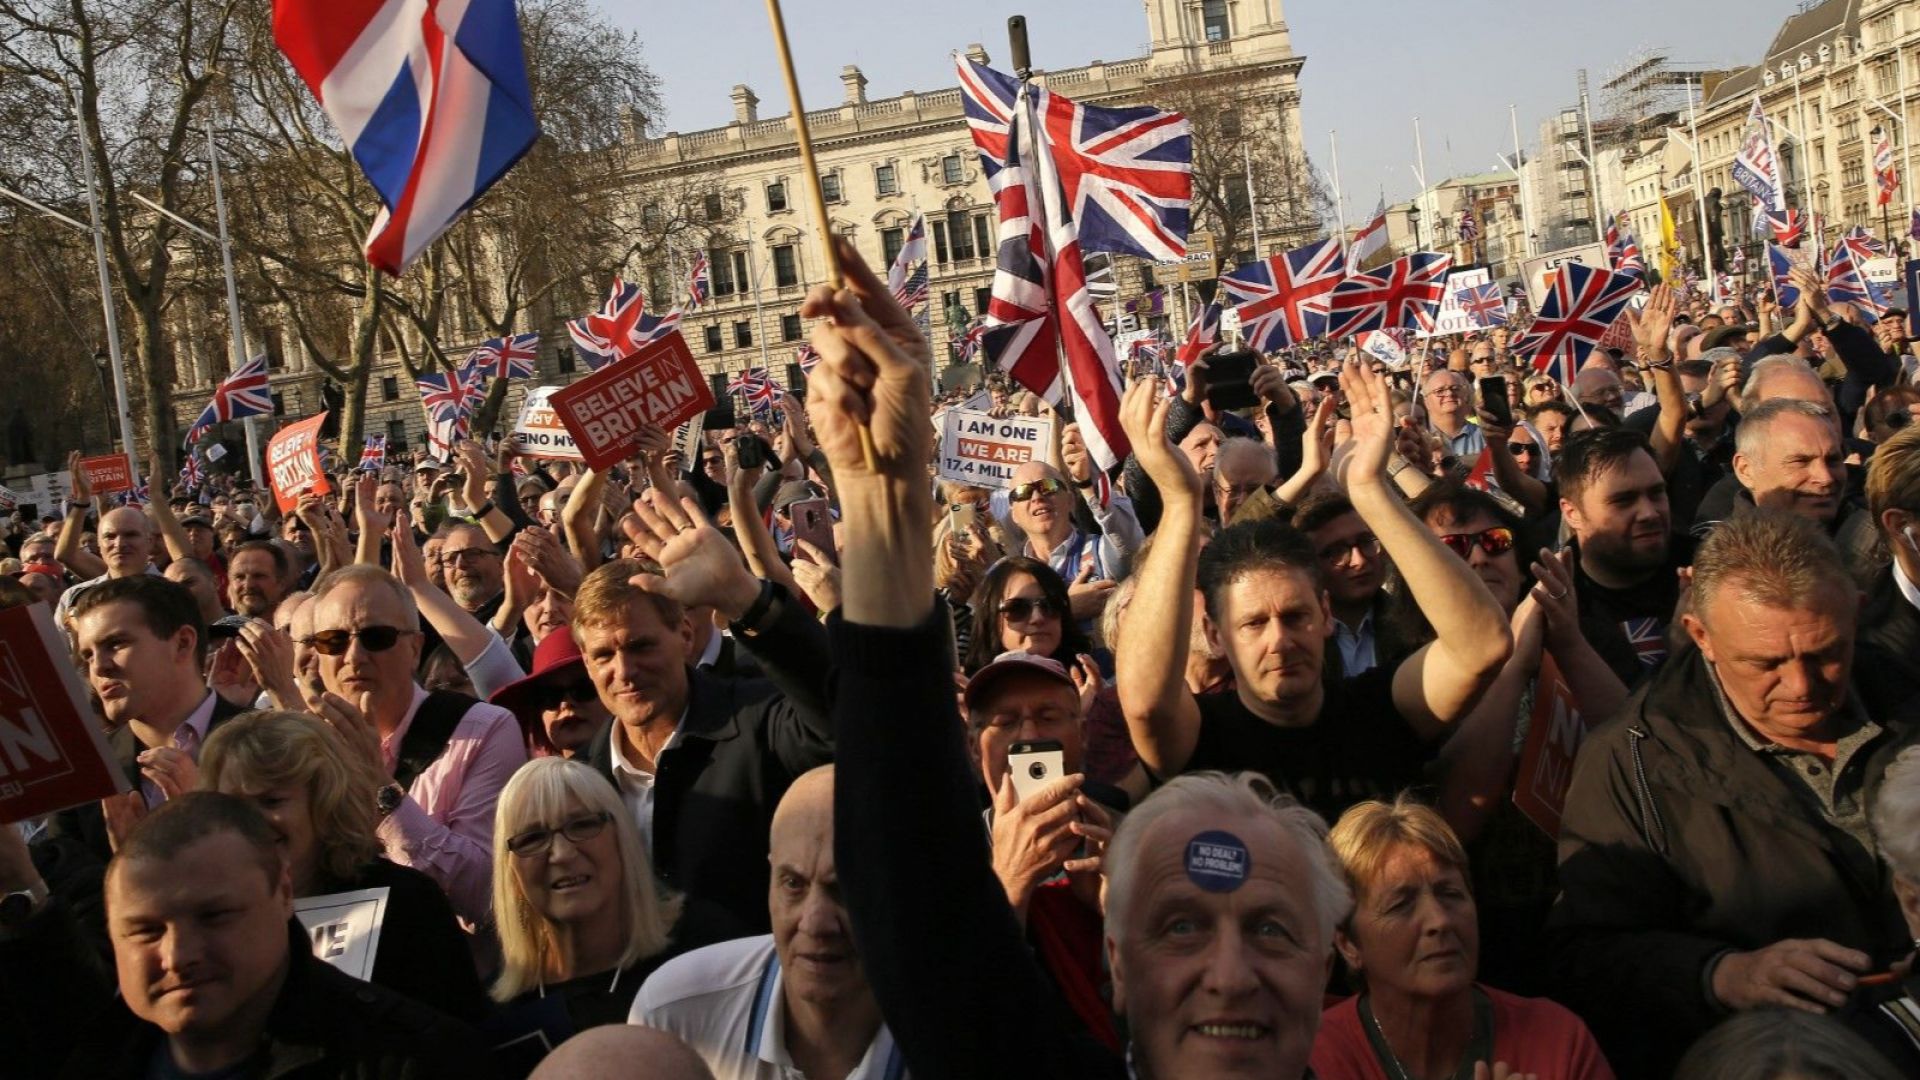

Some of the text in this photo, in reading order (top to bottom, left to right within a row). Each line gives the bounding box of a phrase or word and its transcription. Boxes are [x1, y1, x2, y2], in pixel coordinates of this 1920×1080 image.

[572, 365, 660, 421] BELIEVE
[656, 353, 683, 378] IN
[584, 374, 694, 449] BRITAIN
[958, 420, 1037, 440] I AM ONE
[961, 441, 1030, 462] WE ARE
[272, 448, 318, 493] BRITAIN
[946, 458, 974, 473] 17.4
[1192, 857, 1204, 866] NO
[1199, 846, 1238, 860] NO DEAL?
